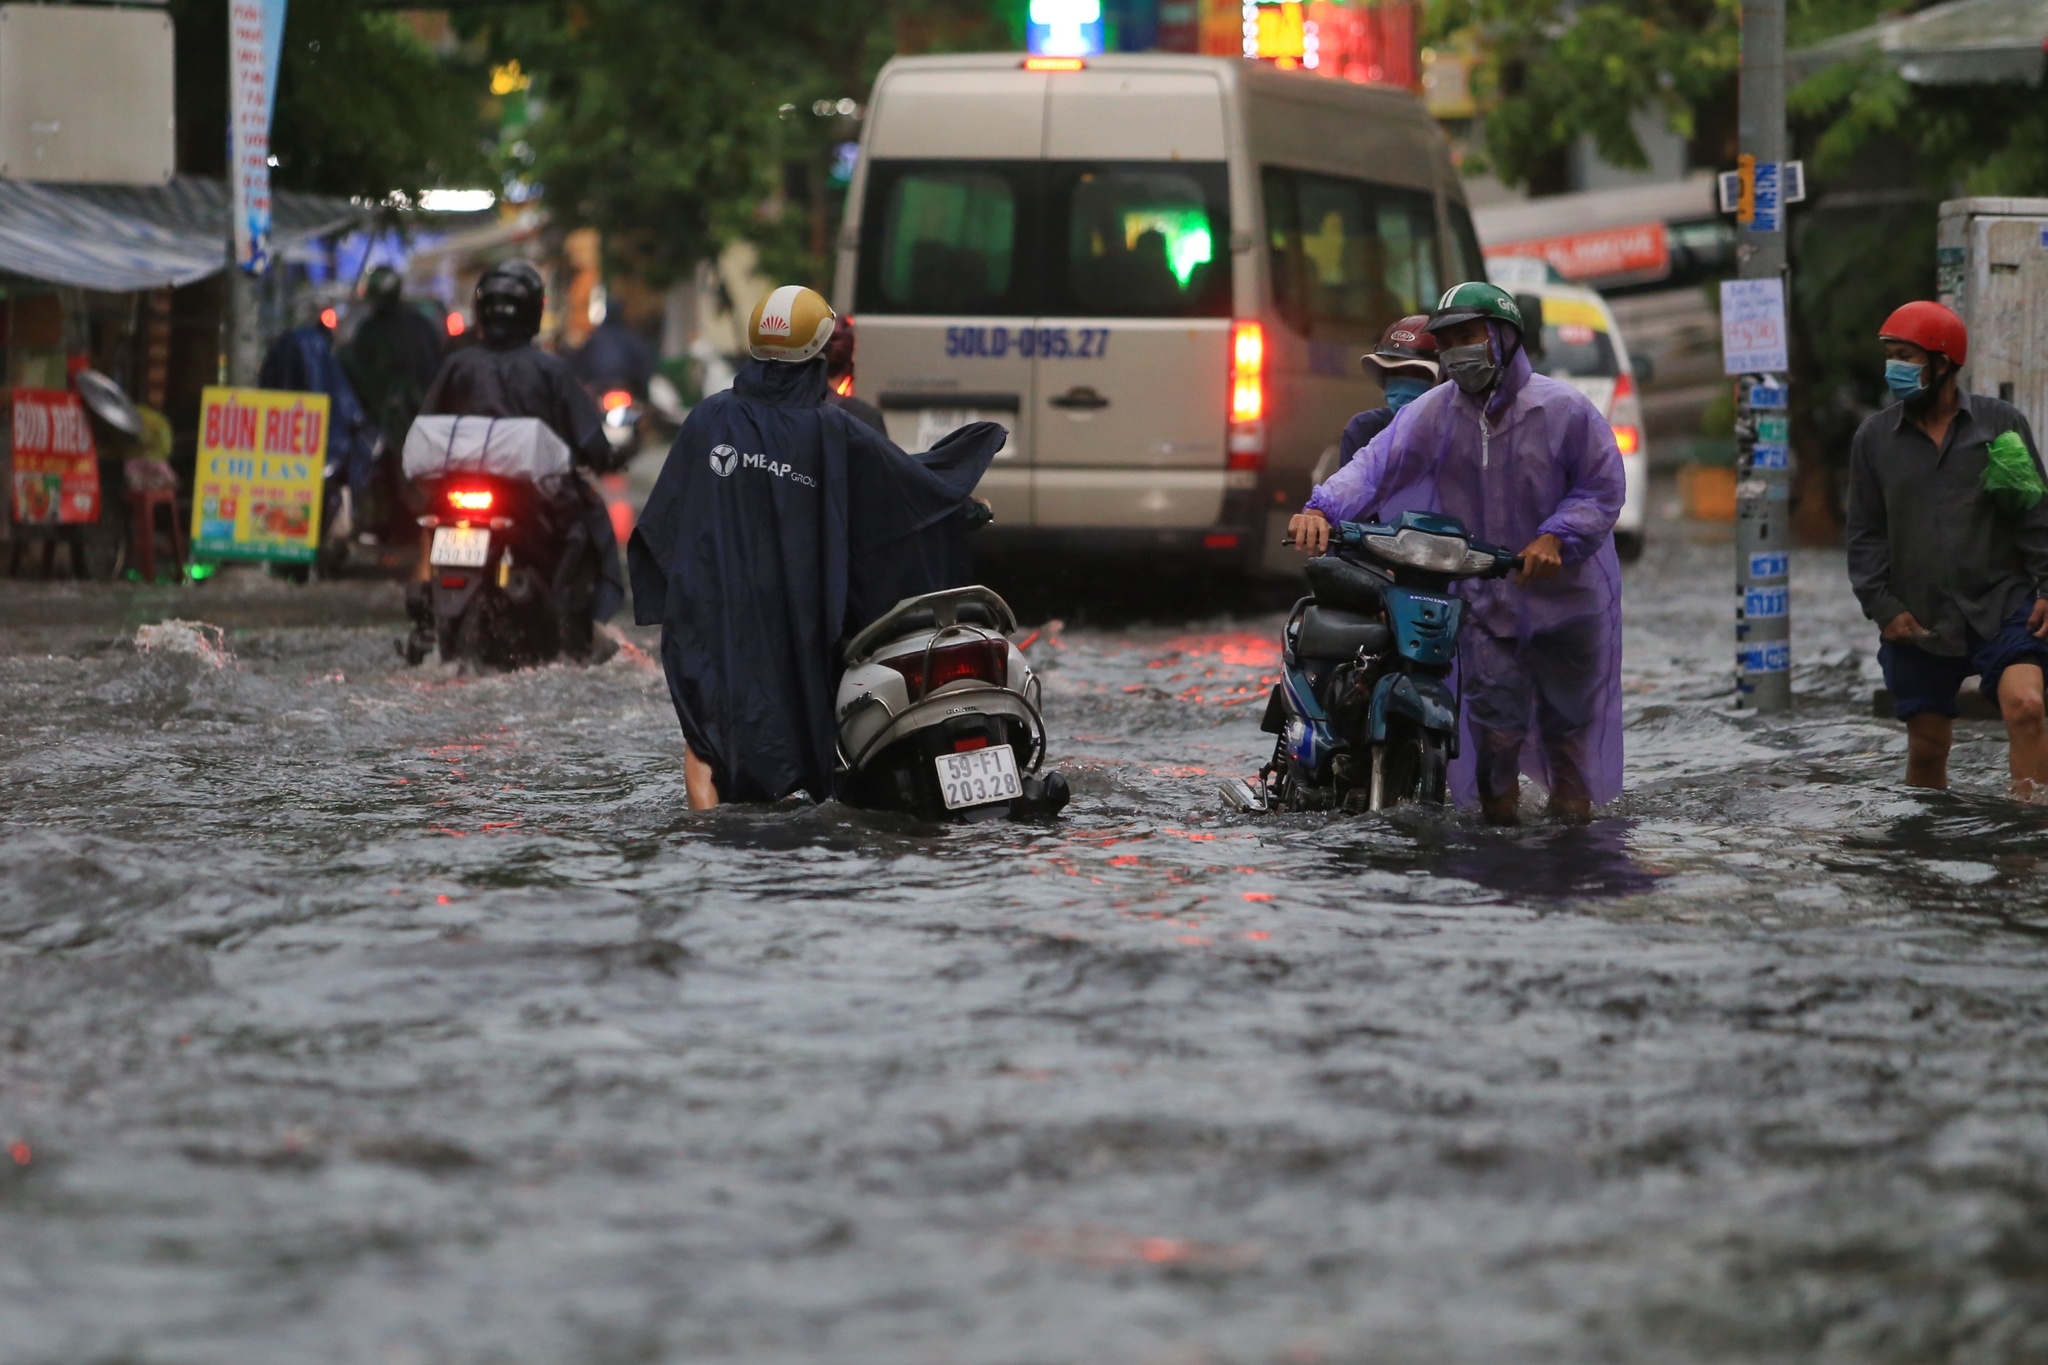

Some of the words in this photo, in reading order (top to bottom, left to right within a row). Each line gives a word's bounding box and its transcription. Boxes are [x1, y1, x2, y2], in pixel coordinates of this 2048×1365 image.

[946, 326, 1110, 358] 50LD-095.27
[205, 391, 258, 450] BÚN
[263, 396, 322, 456] RIÊU
[742, 453, 791, 477] MEAP
[790, 472, 818, 488] GROU
[1409, 594, 1449, 606] HONDA
[947, 752, 1002, 780] 59-F1
[946, 773, 1016, 805] 203.28
